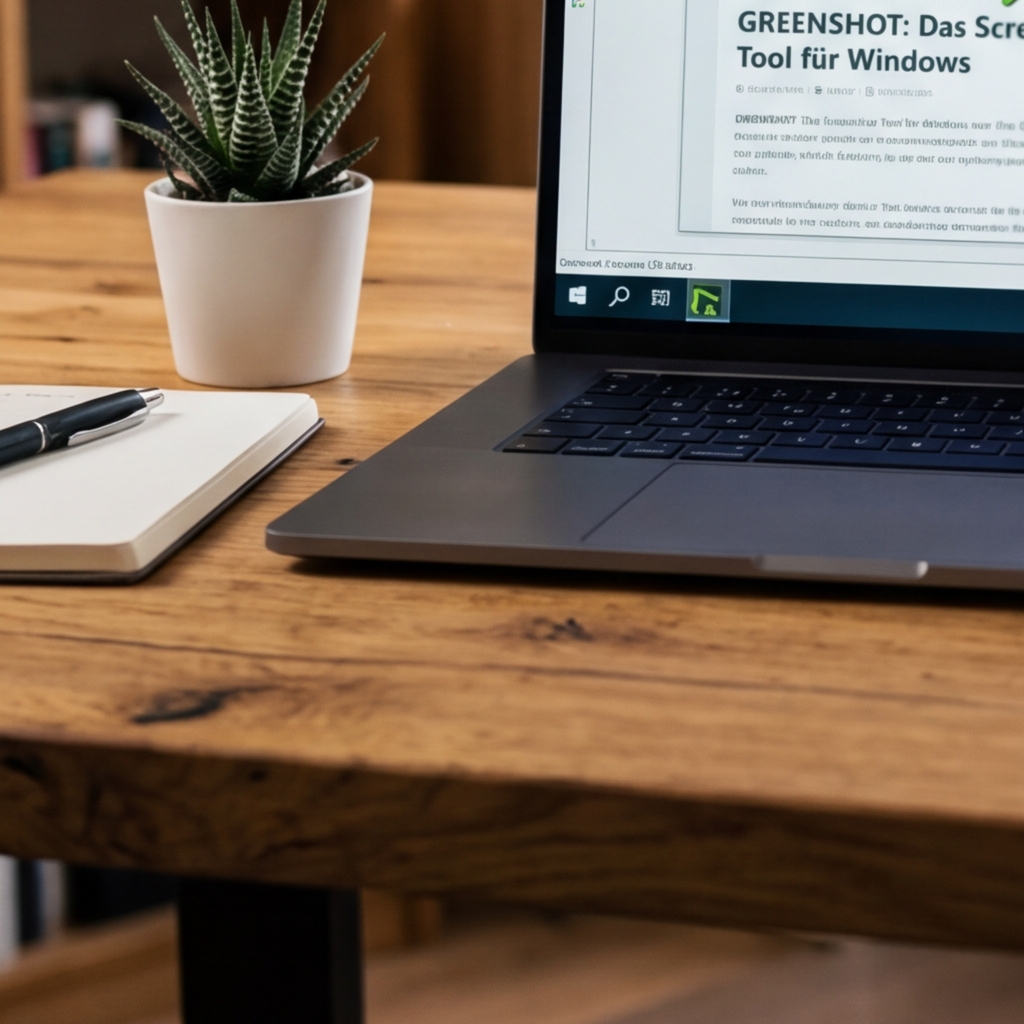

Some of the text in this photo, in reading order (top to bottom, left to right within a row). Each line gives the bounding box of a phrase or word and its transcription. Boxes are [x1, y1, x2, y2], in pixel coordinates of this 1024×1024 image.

[738, 11, 909, 36] GREENSHOT:
[920, 15, 966, 38] Das
[737, 46, 970, 73] Tool für Windows
